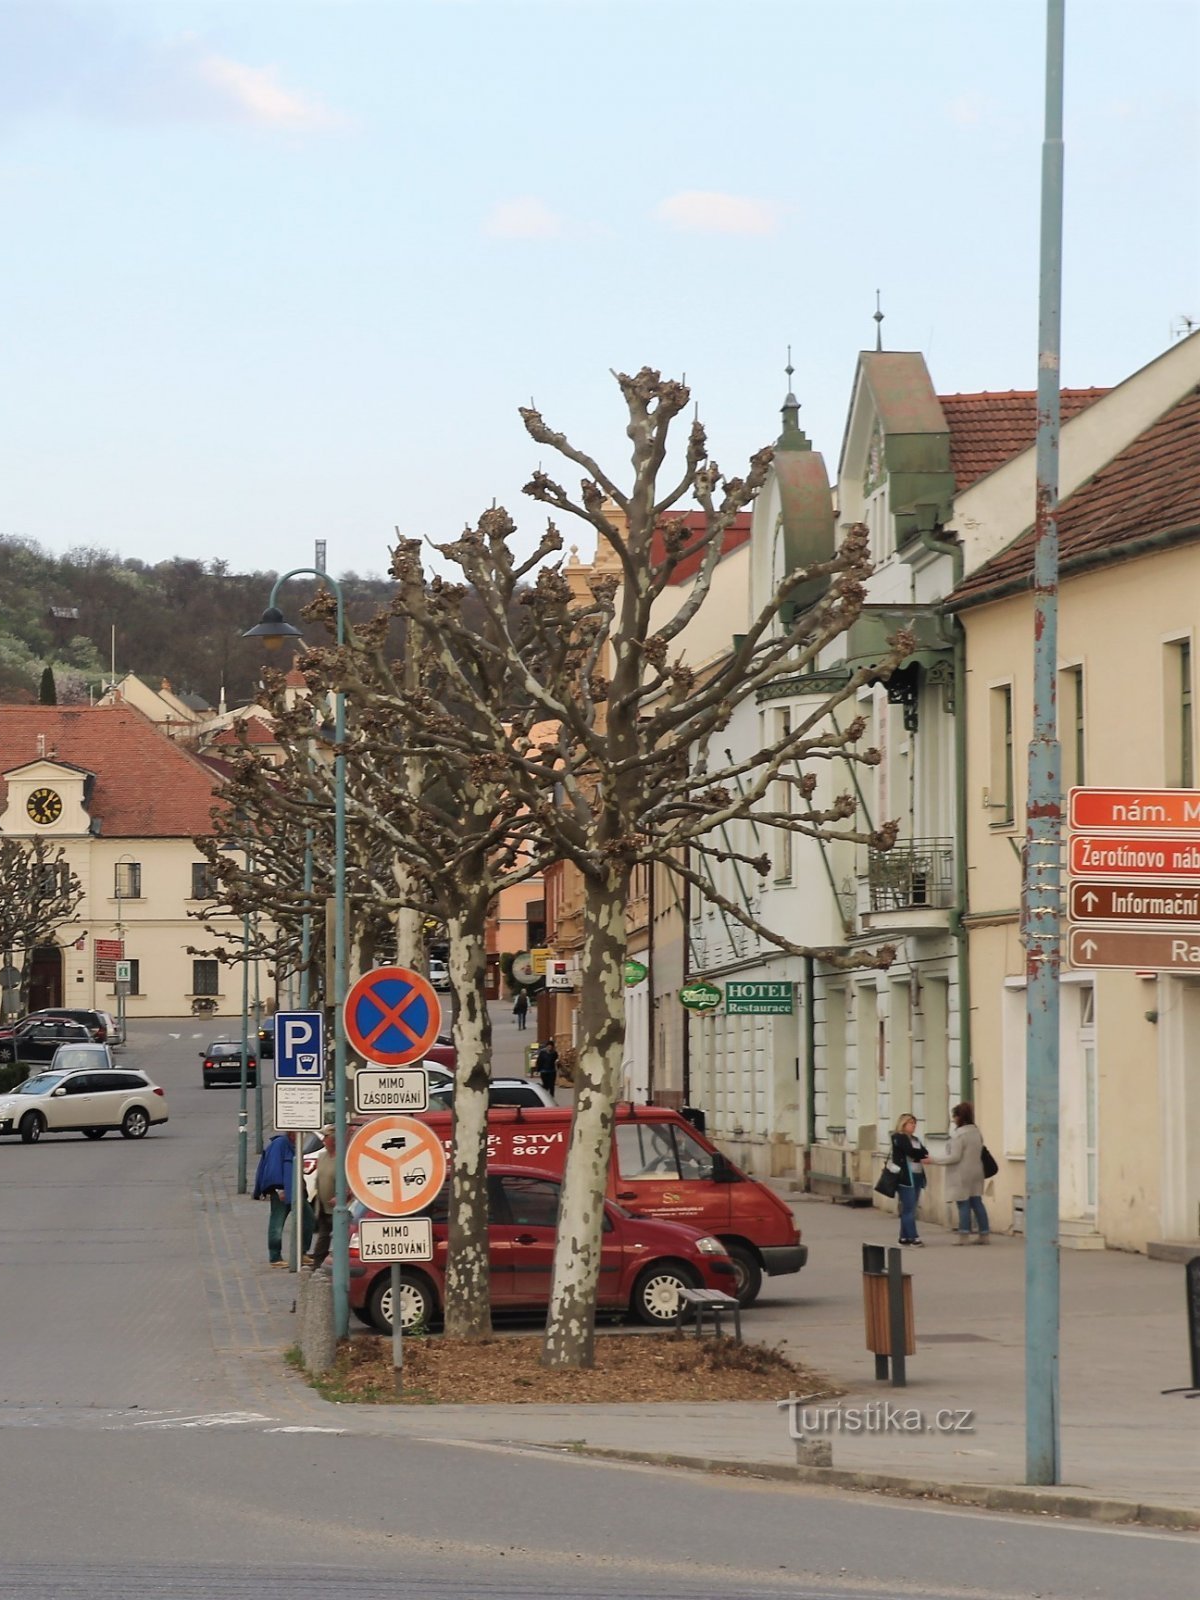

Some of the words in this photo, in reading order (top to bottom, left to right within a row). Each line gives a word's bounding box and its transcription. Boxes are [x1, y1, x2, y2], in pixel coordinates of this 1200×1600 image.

[1112, 800, 1172, 822] nám.
[1081, 839, 1164, 868] Žerotínovo
[1111, 891, 1198, 915] Informační
[1171, 939, 1200, 962] Ra
[551, 977, 570, 985] KB
[728, 984, 791, 998] HOTEL
[728, 1003, 791, 1013] Restaurace
[378, 1078, 405, 1088] MIMO
[363, 1090, 421, 1105] ZÁSOBOVÁNÍ
[513, 1145, 551, 1156] 867
[382, 1226, 409, 1237] MIMO
[365, 1240, 426, 1255] ZÁSOBOVÁNÍ
